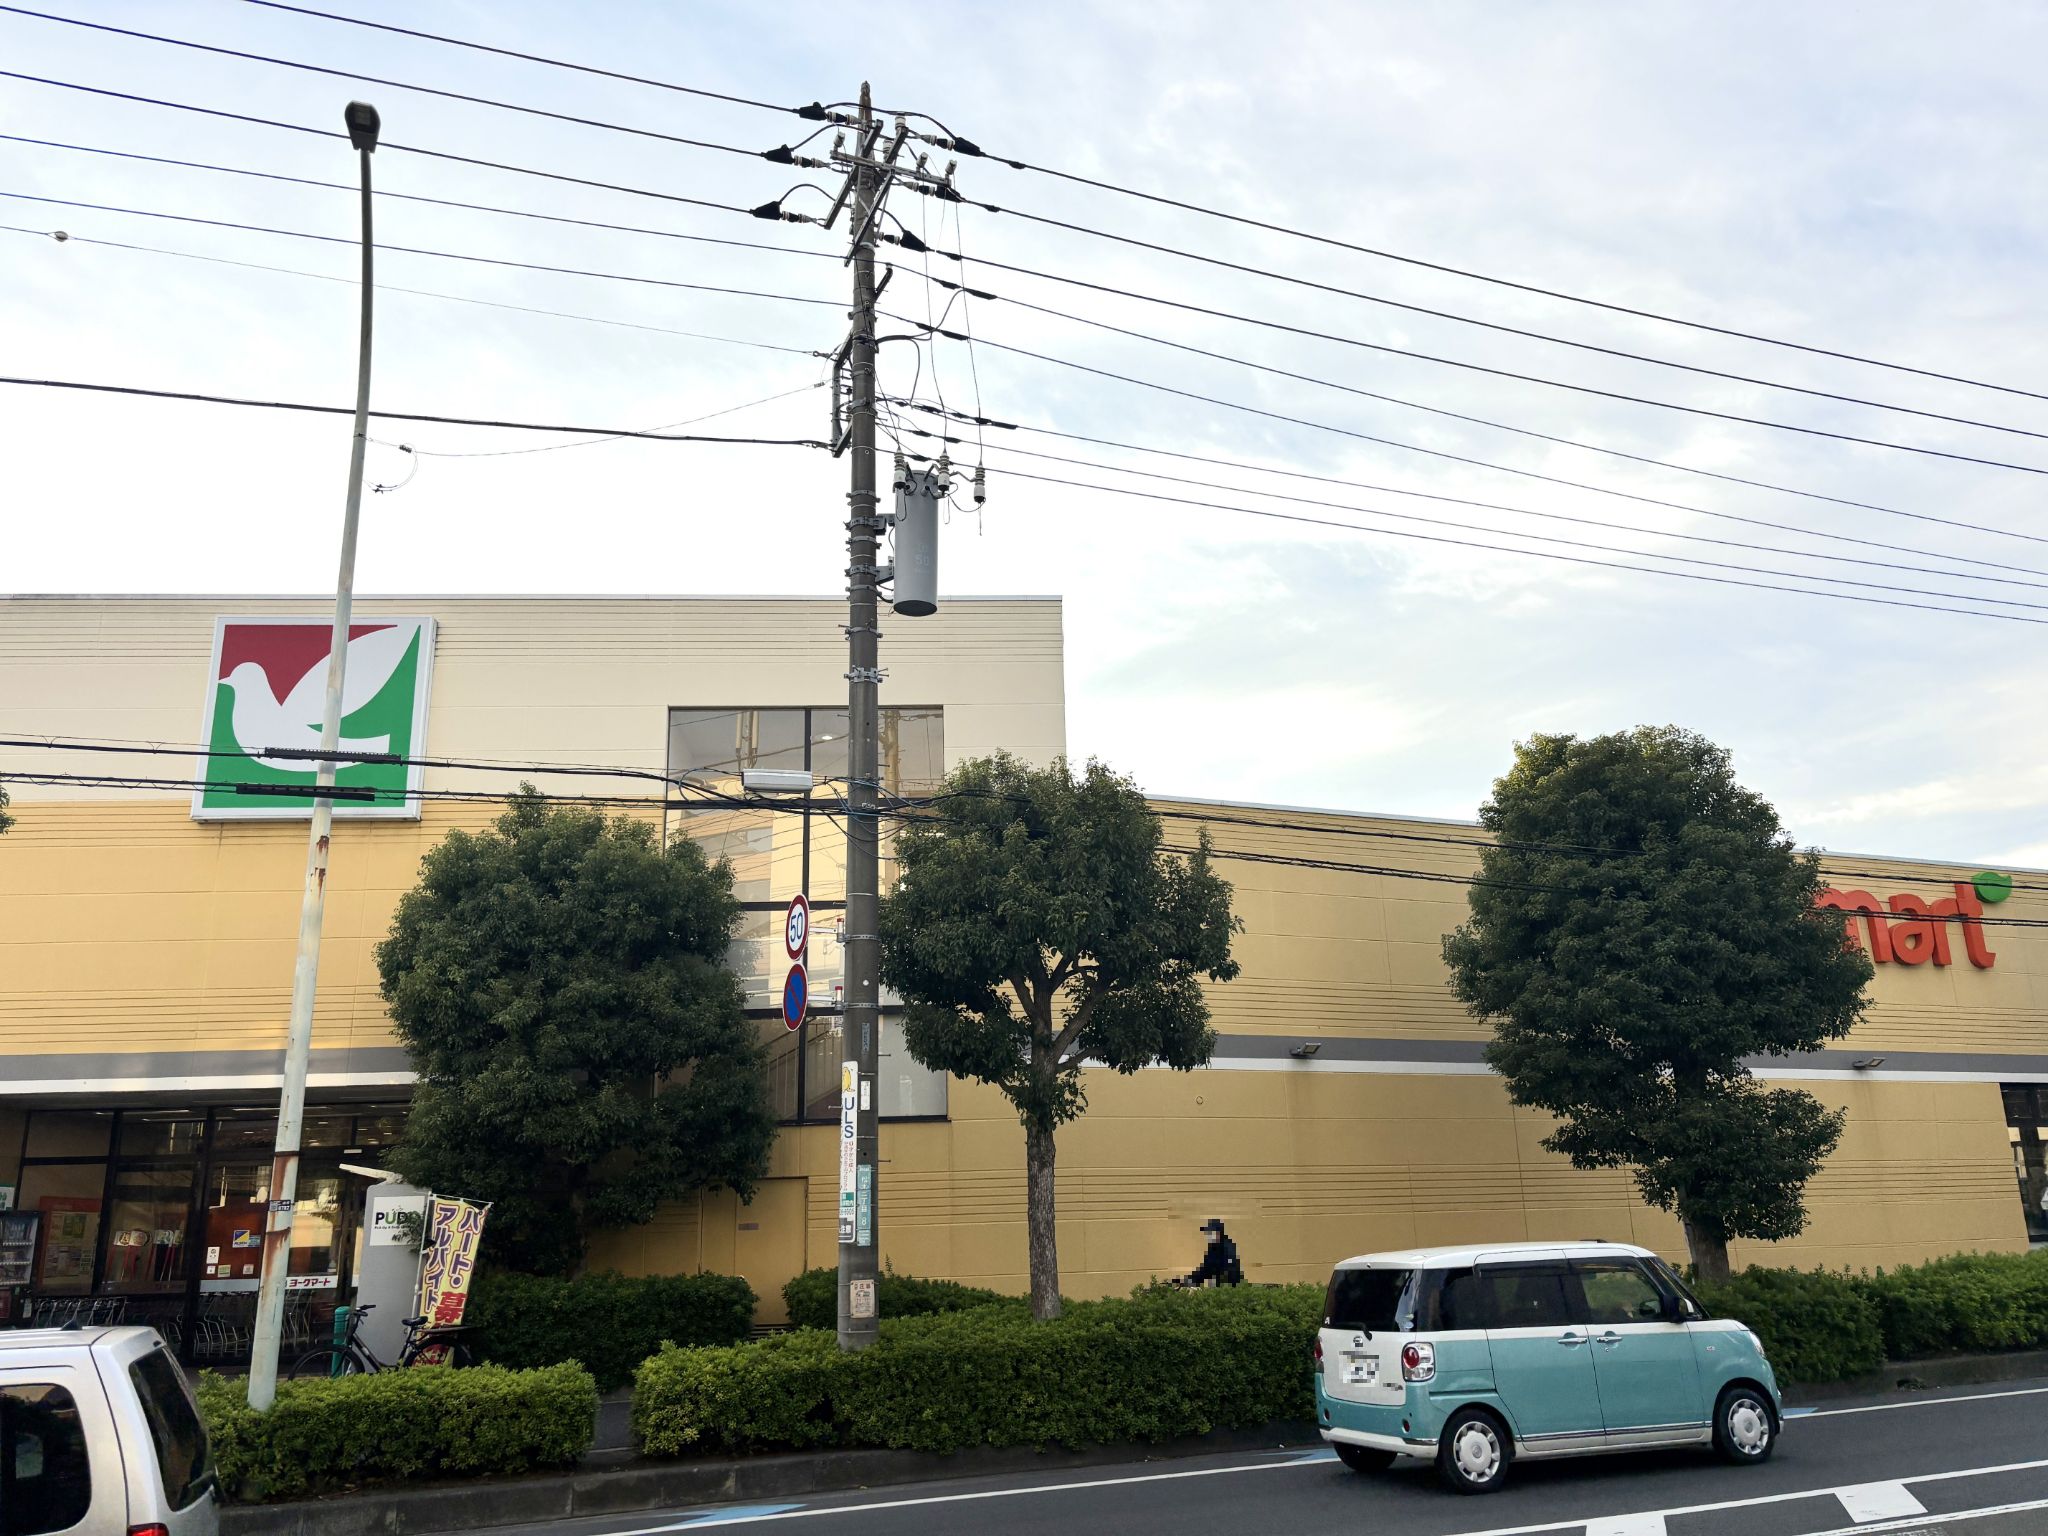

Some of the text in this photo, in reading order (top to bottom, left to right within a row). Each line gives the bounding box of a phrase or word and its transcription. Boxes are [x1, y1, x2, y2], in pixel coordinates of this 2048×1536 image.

[789, 912, 804, 943] 50
[1813, 883, 1997, 969] mart
[289, 1278, 331, 1288] ヨークマート
[424, 1205, 459, 1313] アルバイト
